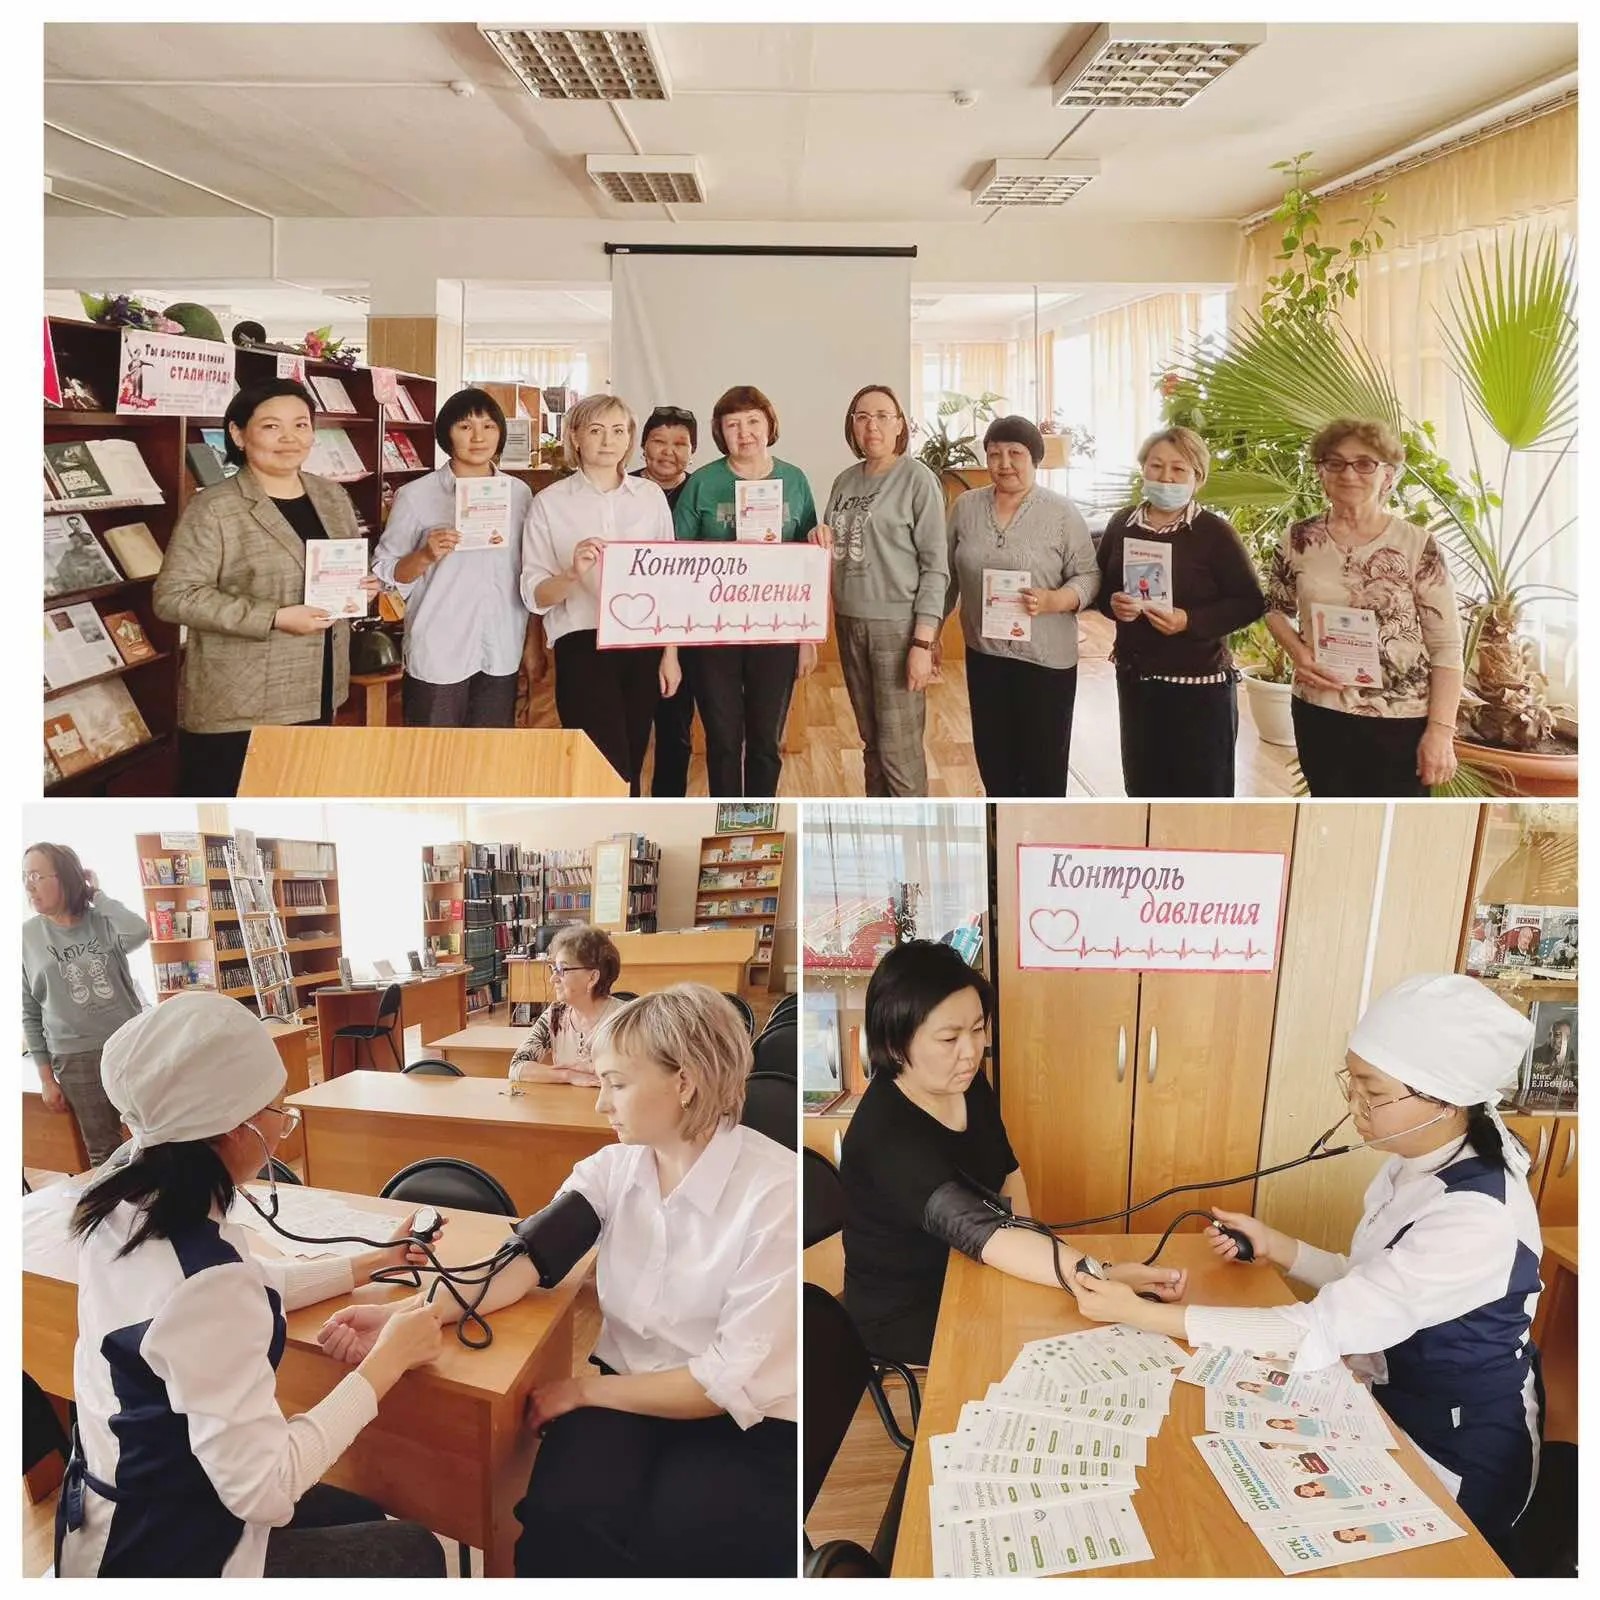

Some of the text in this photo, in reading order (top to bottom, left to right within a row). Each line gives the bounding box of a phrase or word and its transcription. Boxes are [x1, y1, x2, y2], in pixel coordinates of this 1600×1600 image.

[628, 547, 748, 583] Контроль
[708, 575, 812, 603] давления
[1047, 852, 1185, 899] Контроль
[1139, 889, 1261, 926] давления
[1231, 1463, 1270, 1511] ОТКАЖИСЬ
